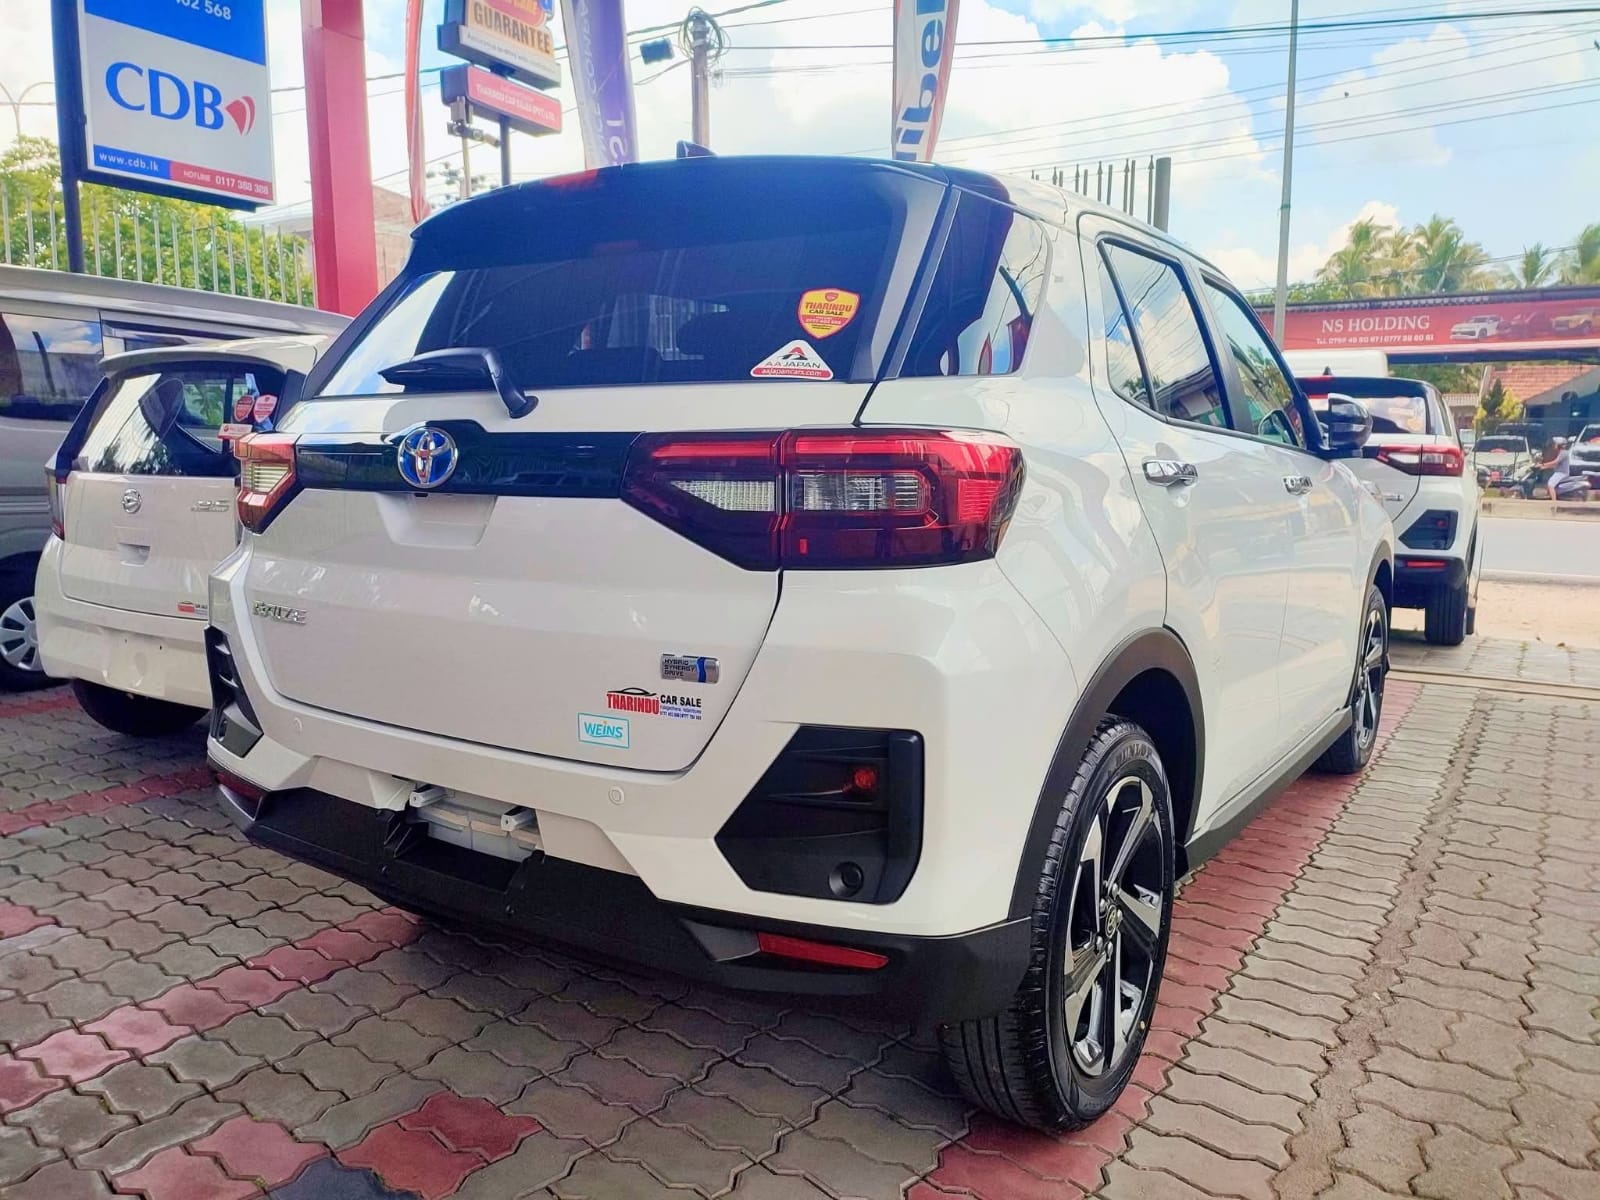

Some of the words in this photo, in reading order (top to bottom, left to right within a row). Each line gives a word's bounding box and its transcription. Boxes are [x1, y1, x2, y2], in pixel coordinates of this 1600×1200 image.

[204, 0, 232, 20] 568
[474, 3, 550, 54] GUARANTEE
[105, 61, 224, 130] CDB
[99, 152, 159, 172] www.cdb.lk
[215, 176, 235, 188] 0117
[805, 302, 853, 312] THARINDU
[1322, 319, 1344, 333] NS
[1348, 315, 1430, 332] HOLDING
[761, 367, 821, 377] aajapancars.com
[664, 664, 696, 672] SYNERGY
[606, 693, 660, 715] THARINDU
[660, 694, 678, 705] CAR
[679, 697, 702, 708] SALE
